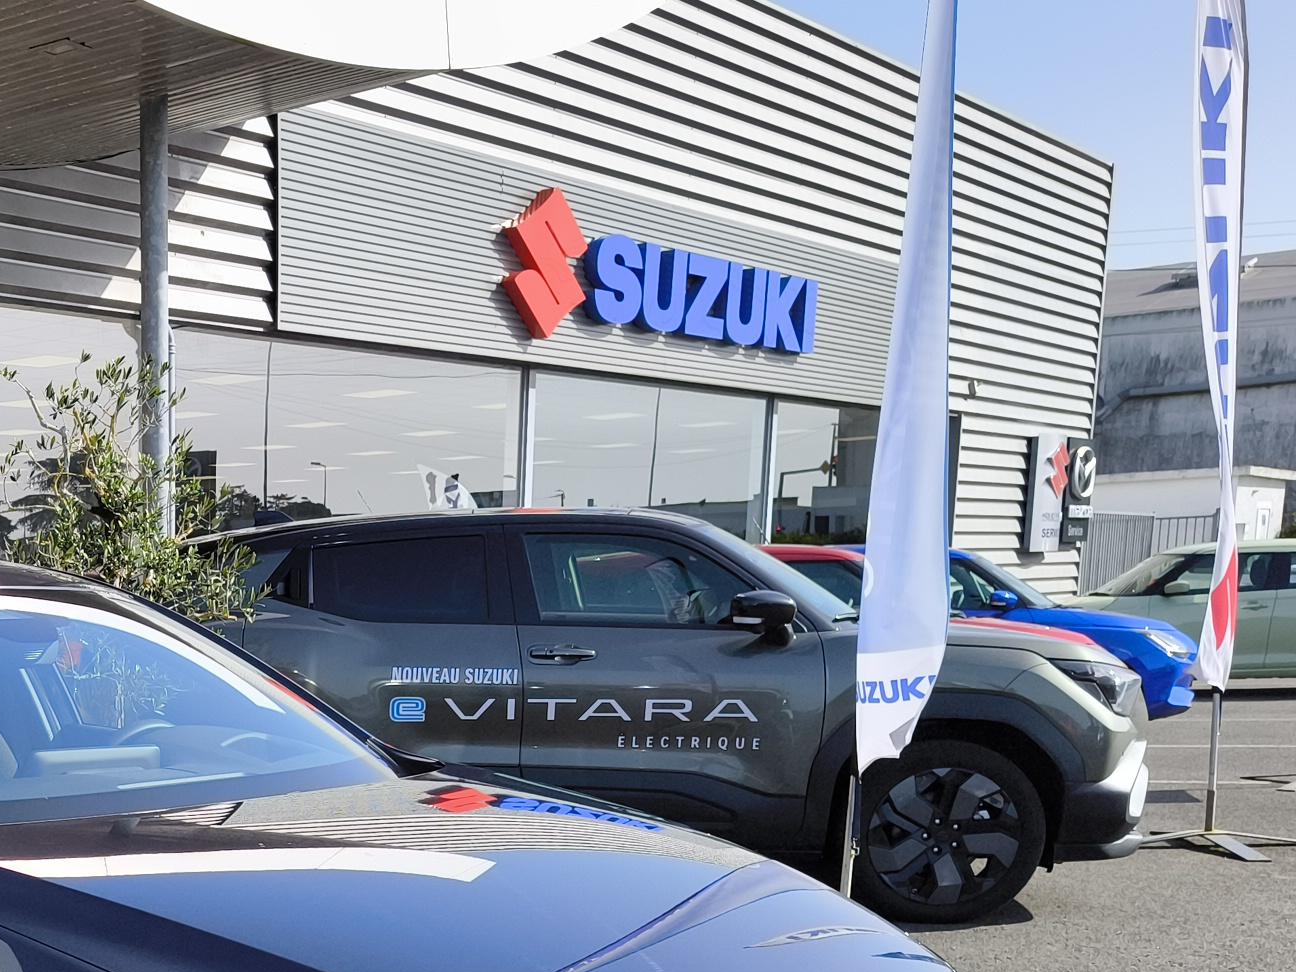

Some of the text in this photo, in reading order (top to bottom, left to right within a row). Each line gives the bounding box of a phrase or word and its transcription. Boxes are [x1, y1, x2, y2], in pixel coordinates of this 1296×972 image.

[584, 233, 819, 355] SUZUKI
[391, 667, 518, 684] NOUVEAU SUZUKI
[856, 675, 936, 704] UZUK
[444, 698, 759, 723] VITARA
[617, 732, 761, 750] ÉLECTRIQUE
